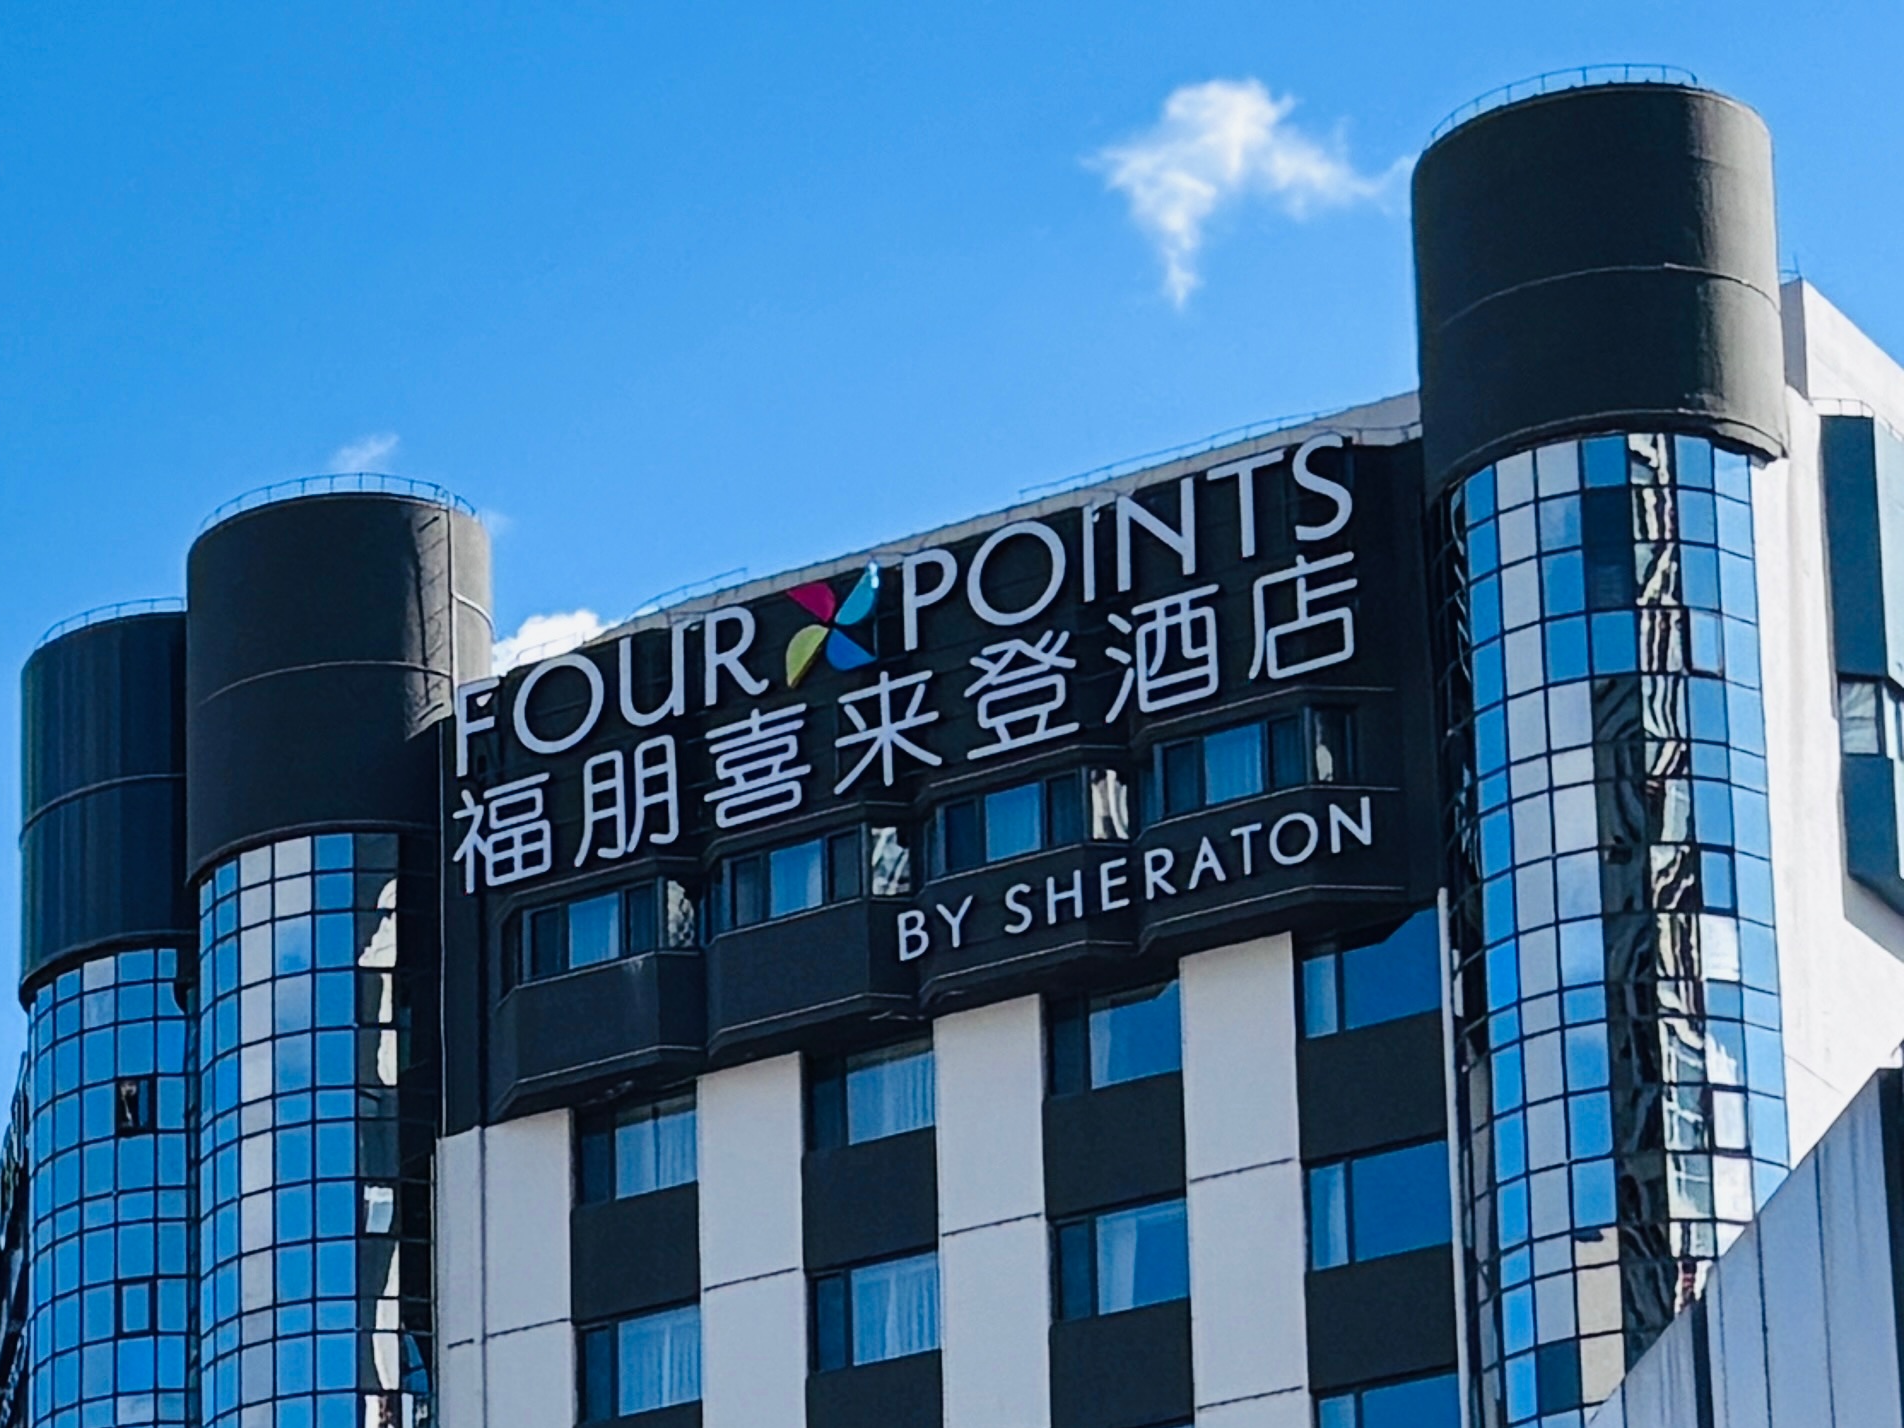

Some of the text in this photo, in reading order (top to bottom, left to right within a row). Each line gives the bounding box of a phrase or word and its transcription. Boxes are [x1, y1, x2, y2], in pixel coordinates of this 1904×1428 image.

[452, 551, 1359, 896] 福朋喜来登酒店
[454, 433, 1353, 778] FOUR POINTS
[896, 796, 1374, 963] BY SHERATON
